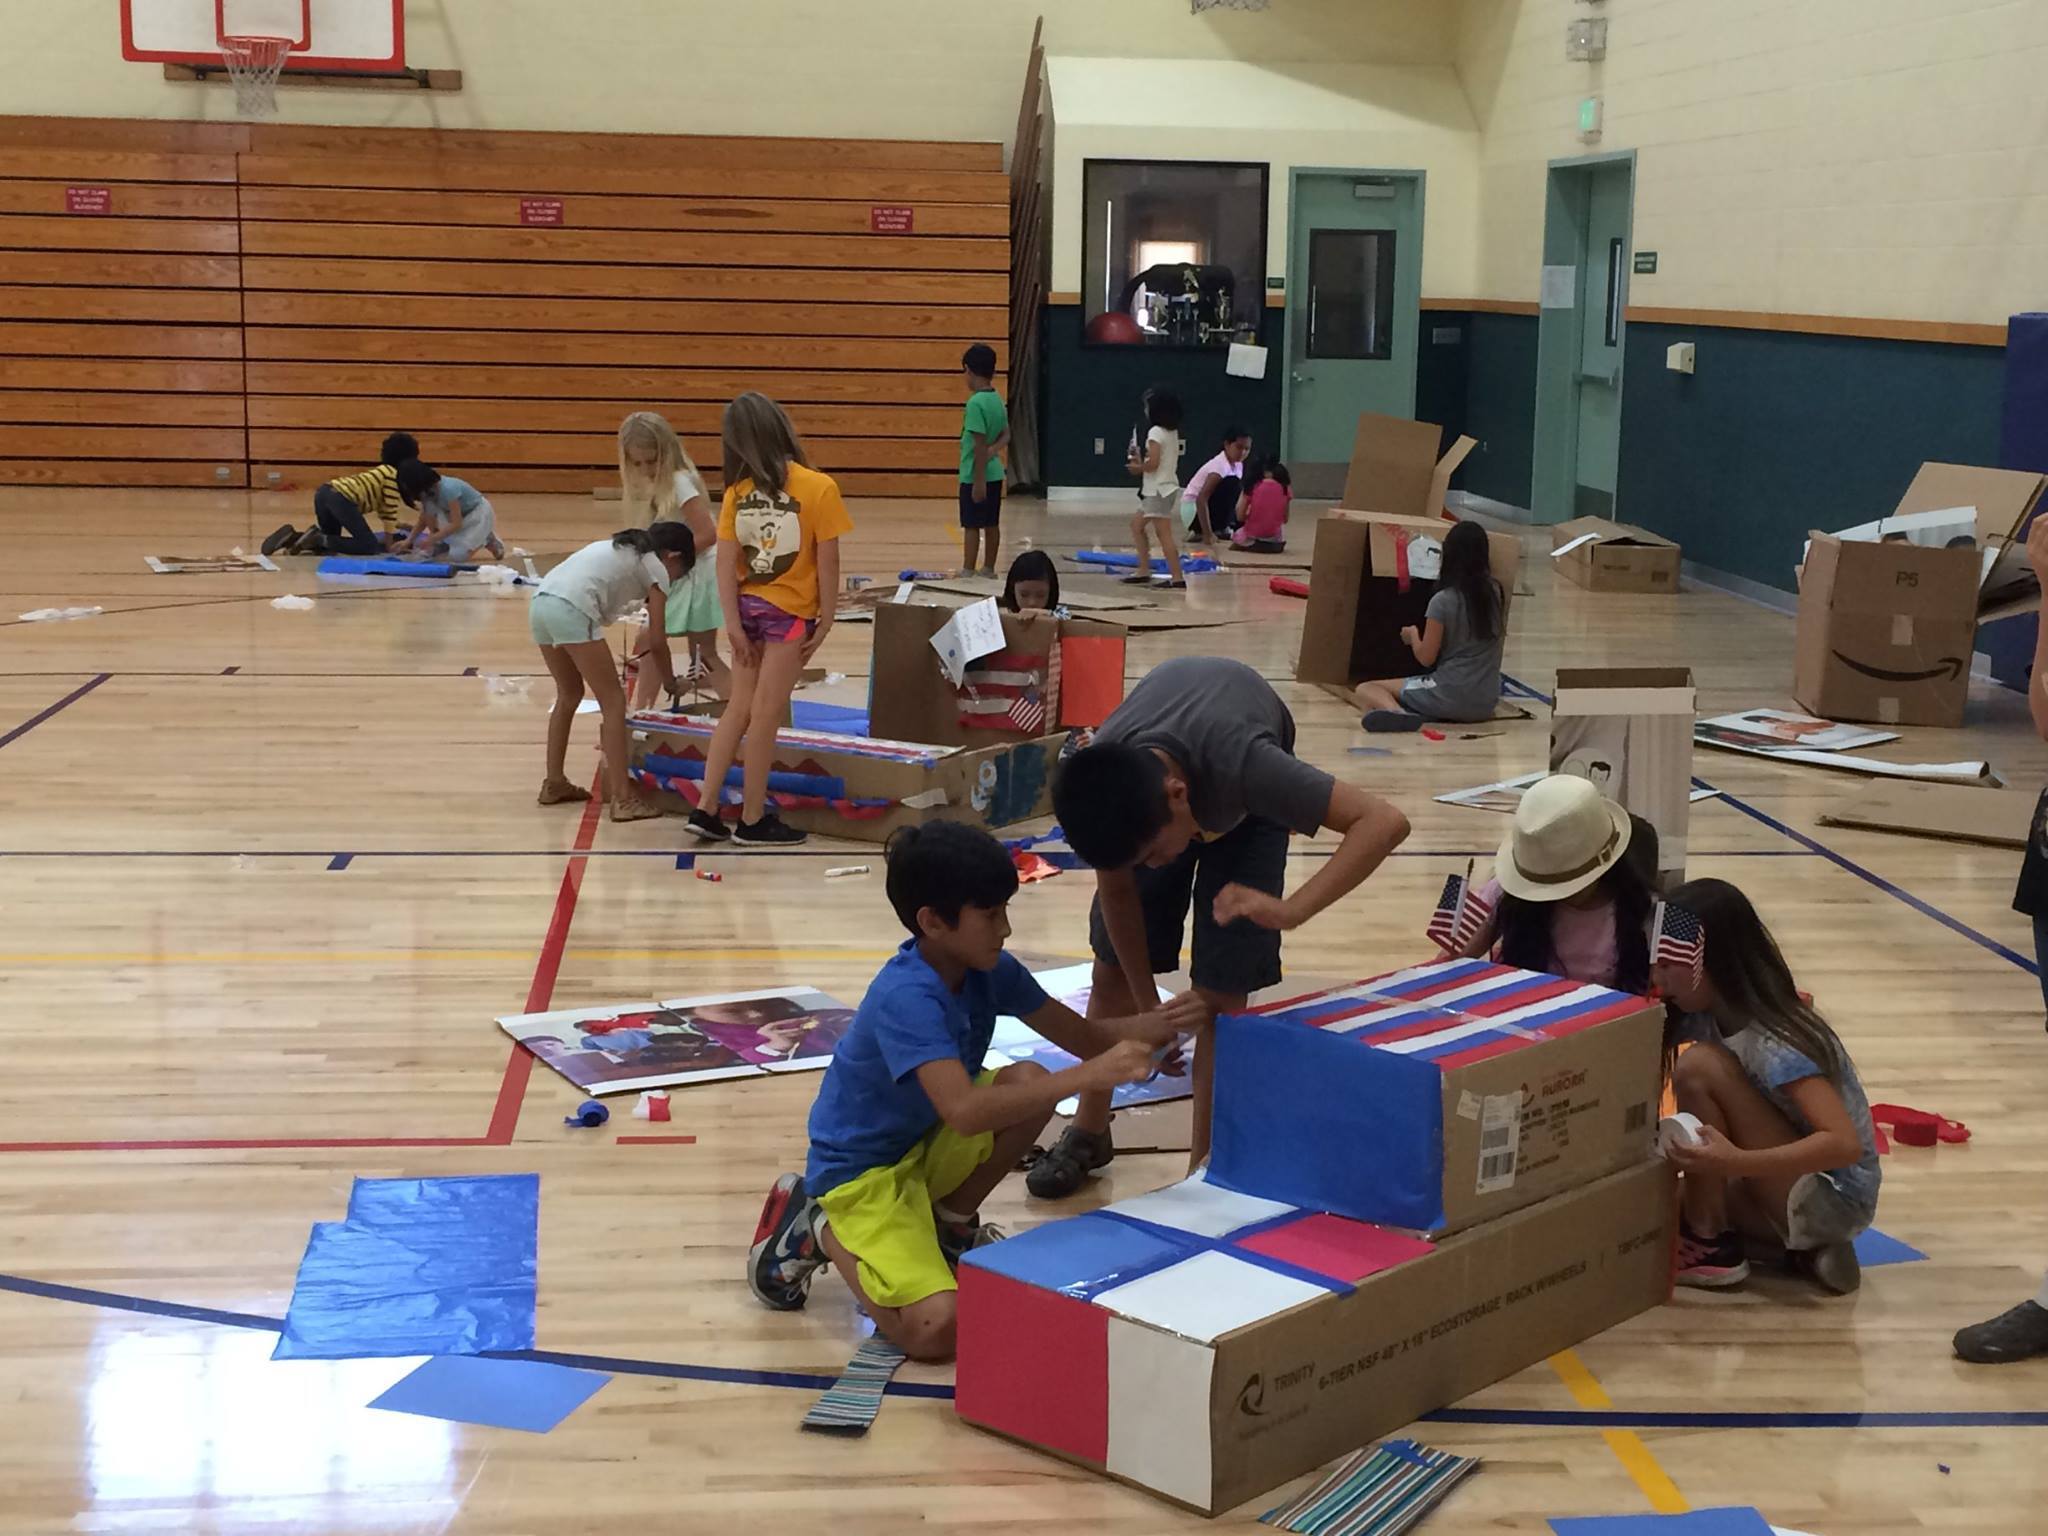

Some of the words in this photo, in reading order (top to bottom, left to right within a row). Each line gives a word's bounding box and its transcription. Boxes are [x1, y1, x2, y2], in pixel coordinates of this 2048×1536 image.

[1542, 1071, 1585, 1098] AURORA
[1430, 1296, 1502, 1340] ECOSTORAGE
[1505, 1284, 1534, 1306] RACK
[1274, 1361, 1316, 1392] TRINITY
